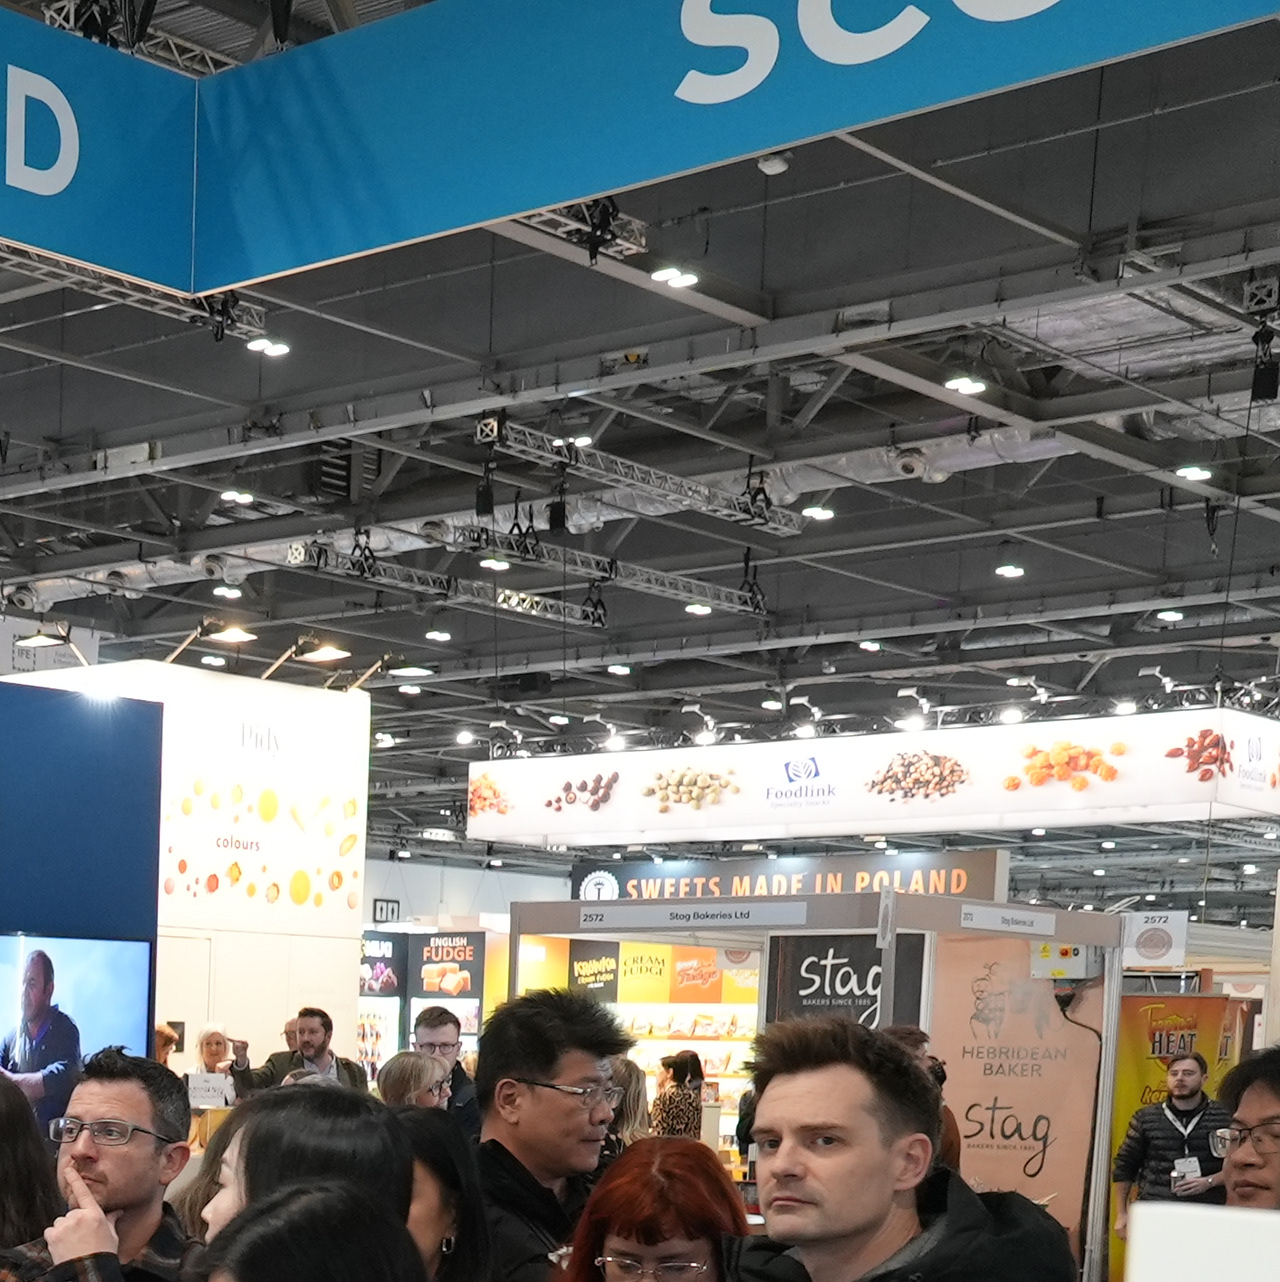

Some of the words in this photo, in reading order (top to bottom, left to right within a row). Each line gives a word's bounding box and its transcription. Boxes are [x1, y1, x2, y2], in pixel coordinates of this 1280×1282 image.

[673, 0, 1062, 104] SC
[766, 784, 837, 800] Foodlink
[216, 835, 260, 852] colours
[626, 876, 721, 899] SWEETS
[731, 873, 803, 897] MADE
[815, 873, 843, 894] IN
[855, 868, 968, 894] POLAND
[583, 913, 604, 922] 2572
[669, 911, 691, 921] Stag
[693, 911, 733, 920] Bakeries
[734, 910, 750, 919] Ltd
[1144, 916, 1169, 924] 2572
[430, 937, 467, 947] ENGLISH
[423, 946, 474, 961] FUDGE
[623, 955, 665, 968] CREAM
[623, 966, 664, 977] FUDGE
[798, 948, 882, 1030] stag
[802, 998, 830, 1006] BAKERS
[831, 998, 853, 1006] SINCE
[1151, 1032, 1197, 1057] HEAT
[962, 1046, 1068, 1060] HEBRIDEAN
[983, 1063, 1042, 1077] BAKER
[963, 1096, 1057, 1178] stag
